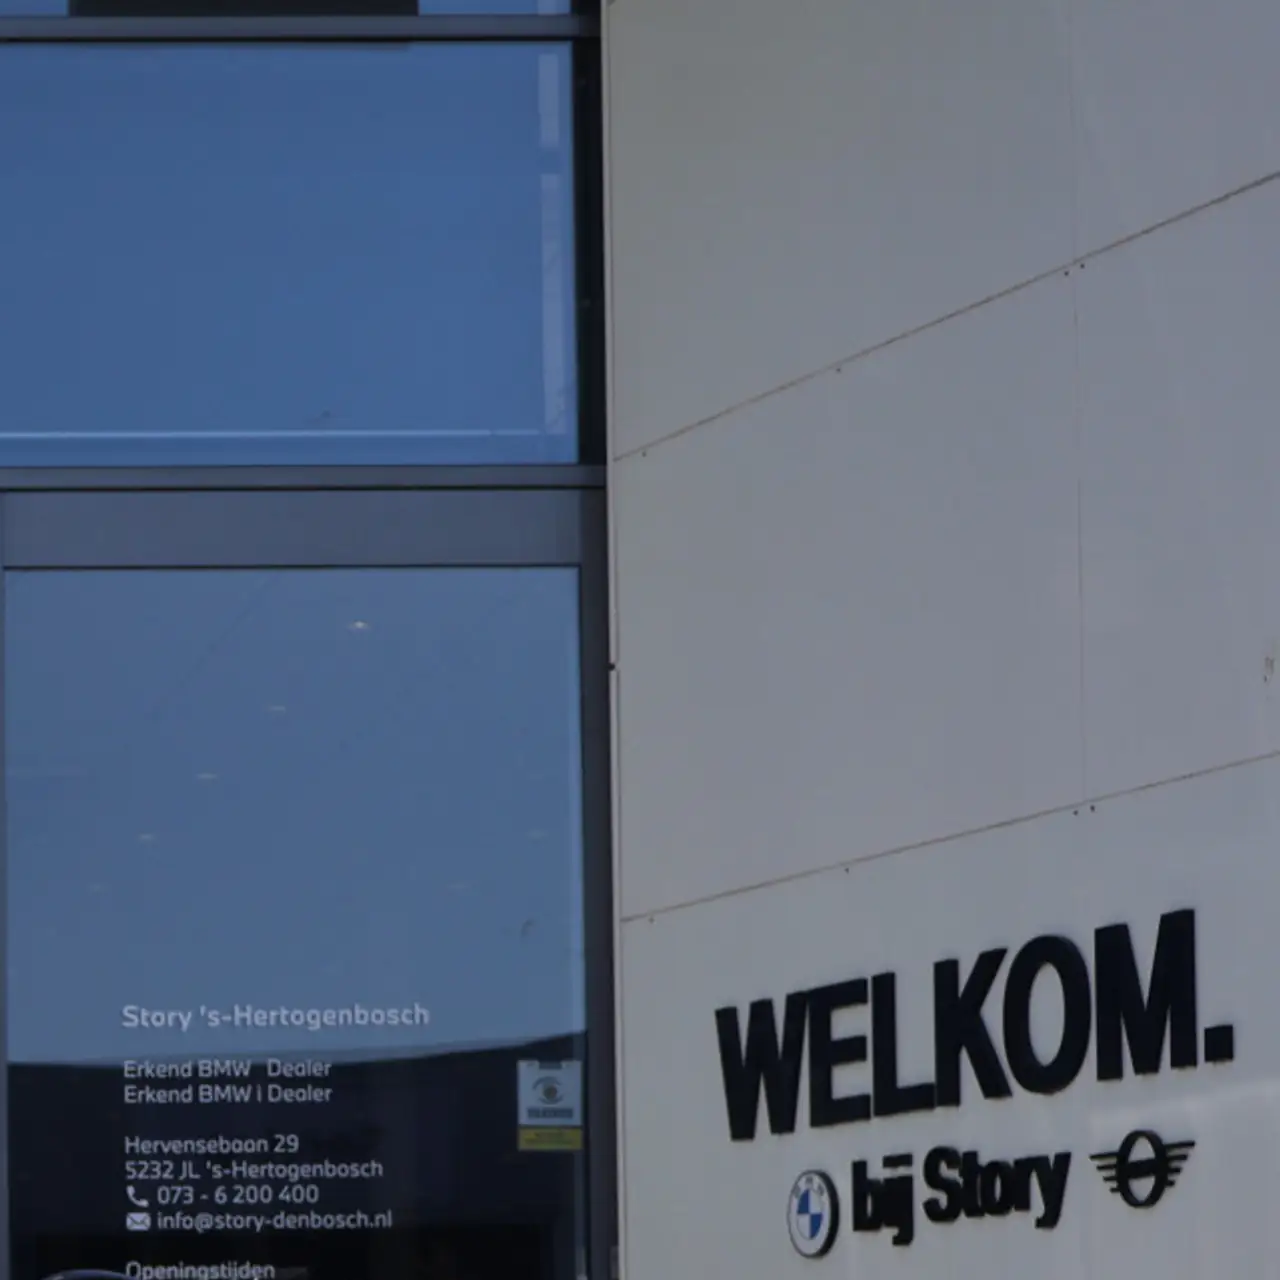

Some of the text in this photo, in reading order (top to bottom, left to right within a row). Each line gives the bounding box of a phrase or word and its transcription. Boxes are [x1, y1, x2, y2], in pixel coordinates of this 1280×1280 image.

[121, 1003, 430, 1032] Story 's-Hertogenbosch
[714, 908, 1235, 1142] WELKOM.
[123, 1059, 331, 1079] Erkend BMW Dealer
[124, 1084, 333, 1103] Erkend BMW i Dealer
[125, 1134, 300, 1155] Hervensebaan 29
[125, 1159, 384, 1182] 5232 JL 's-Hertogenbosch
[157, 1186, 195, 1205] 073
[214, 1186, 227, 1204] 6
[232, 1185, 273, 1204] 200
[278, 1184, 320, 1203] 400
[851, 1146, 1072, 1246] bij Story
[157, 1209, 392, 1234] info@story-denbosch.nl
